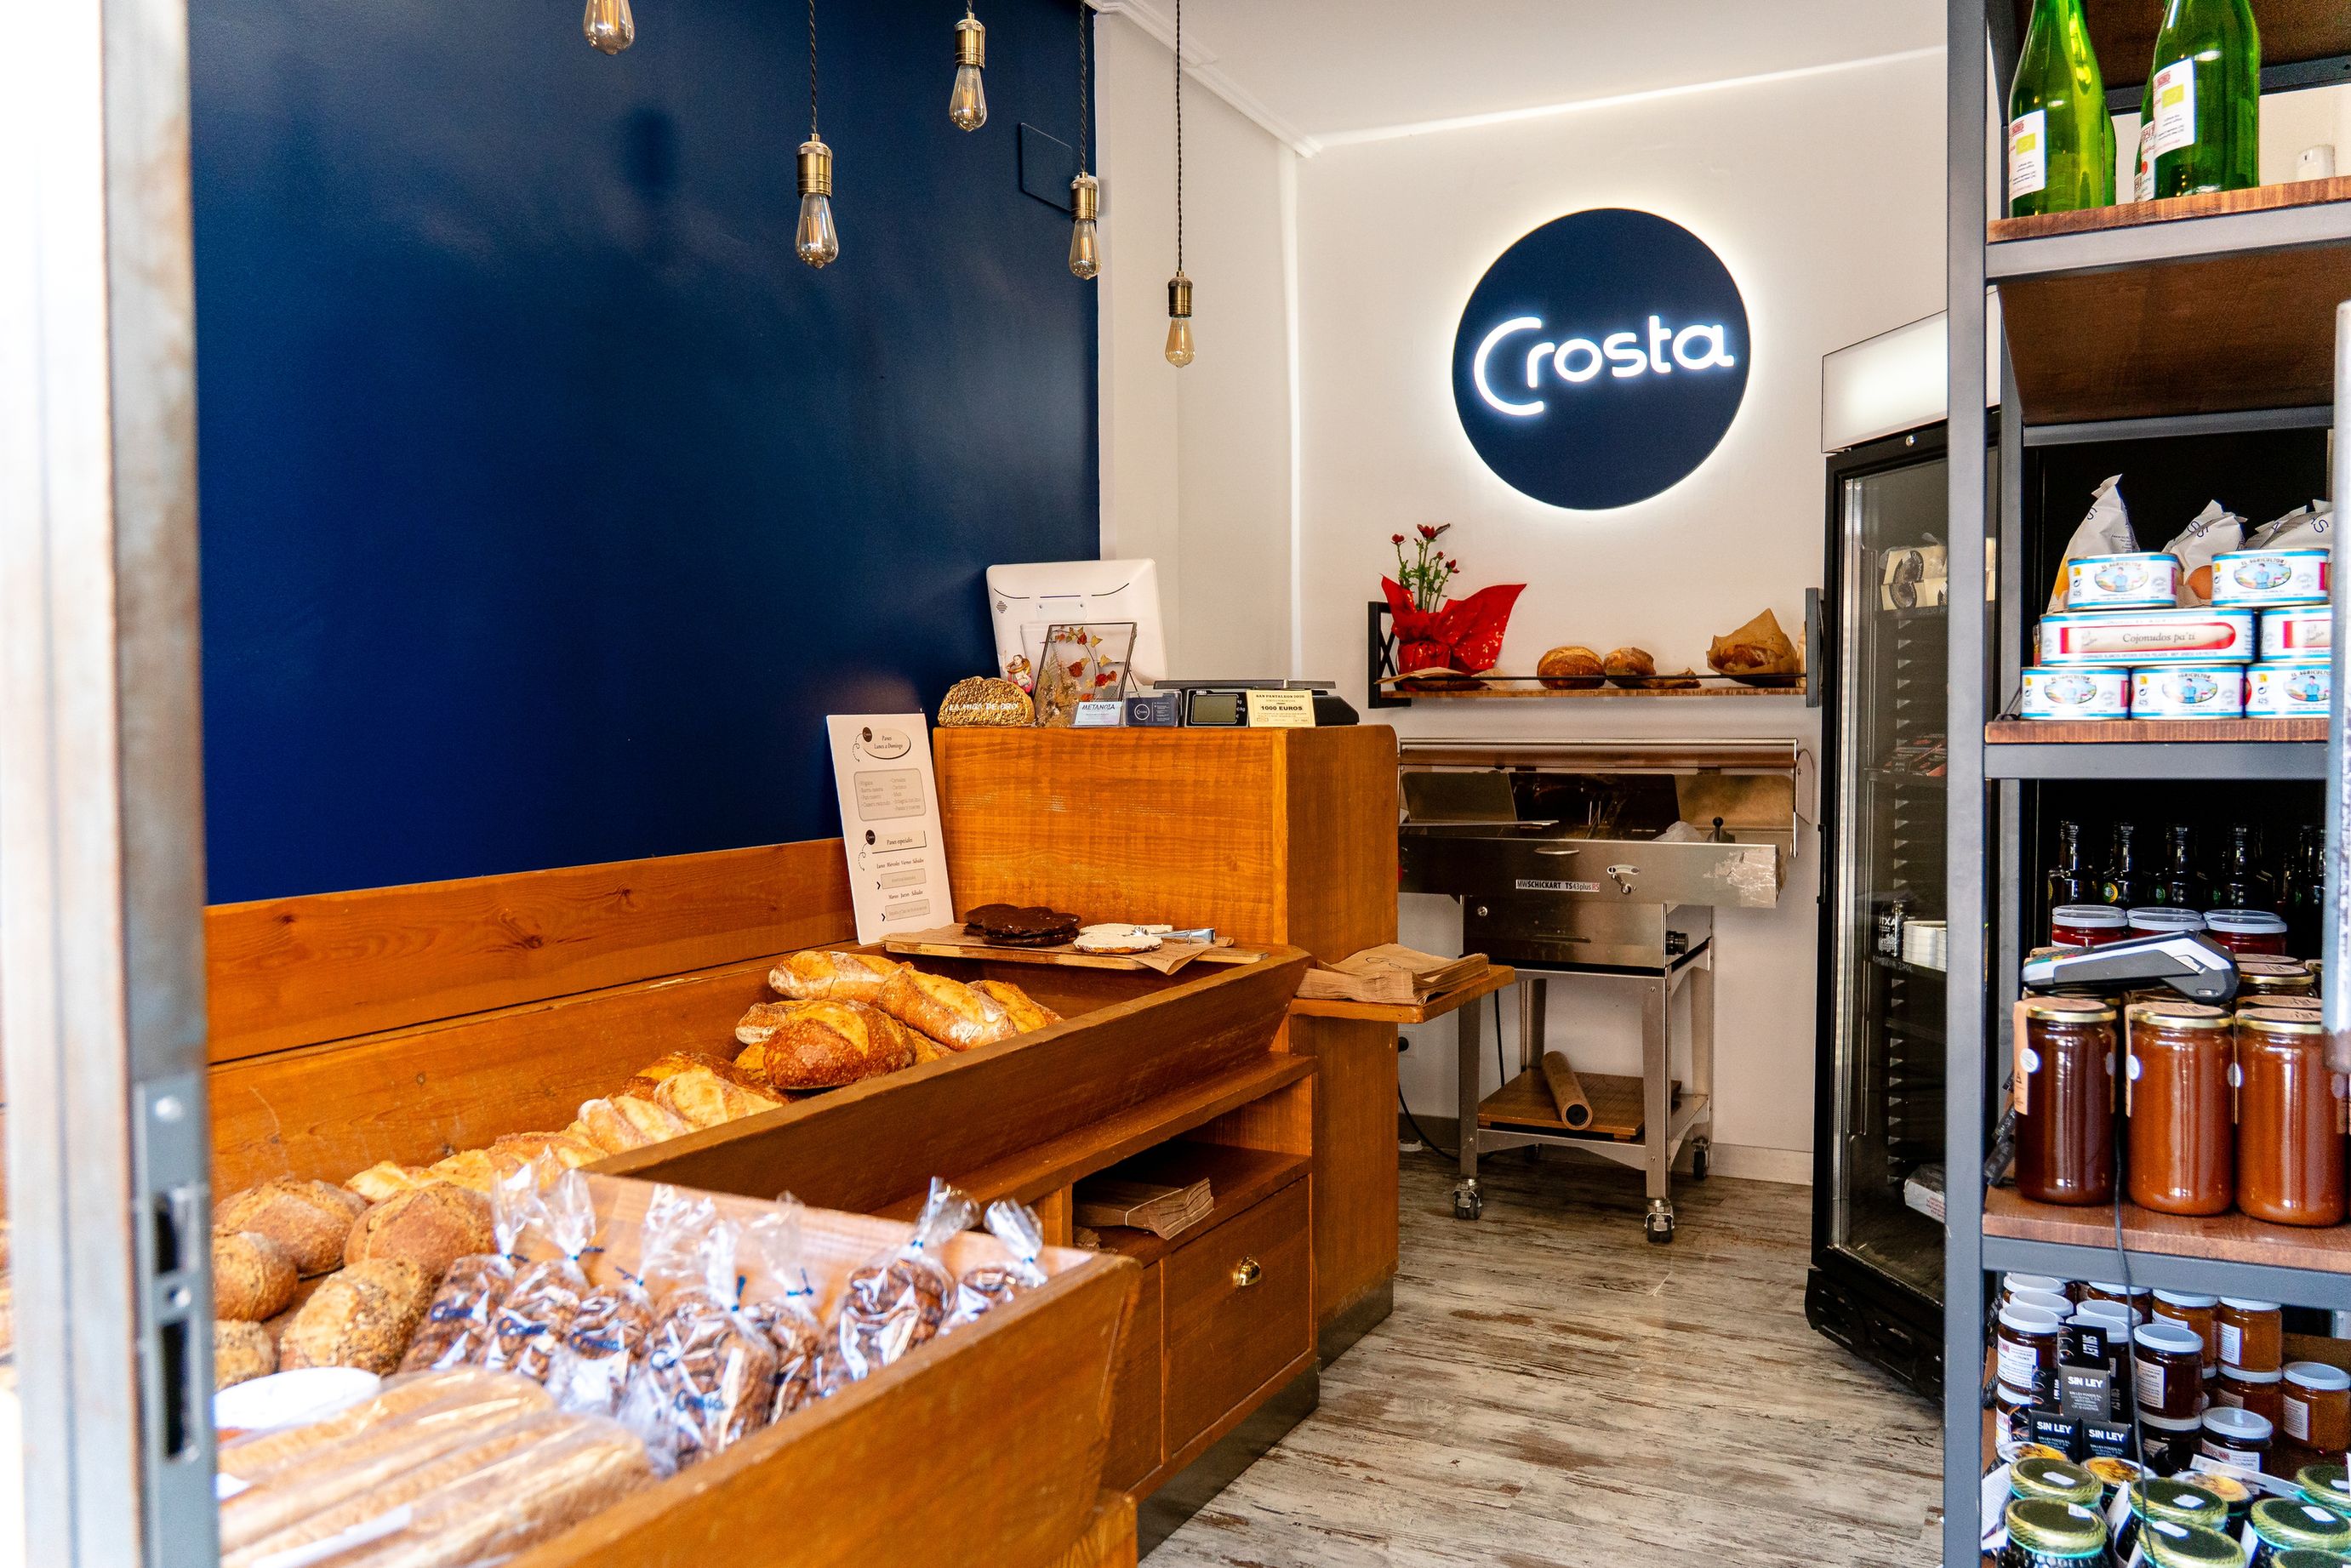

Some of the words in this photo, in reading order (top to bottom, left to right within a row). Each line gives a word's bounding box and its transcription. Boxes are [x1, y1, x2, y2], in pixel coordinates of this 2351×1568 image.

[1473, 315, 1735, 416] Crosta
[2122, 632, 2171, 644] Cojonudos
[949, 703, 961, 711] LA
[962, 703, 983, 711] MIGA
[985, 702, 997, 710] DE
[1000, 702, 1019, 710] ORO
[2068, 1376, 2083, 1386] SIN
[2085, 1377, 2103, 1388] LEY
[2036, 1421, 2052, 1432] SIN
[2053, 1423, 2072, 1434] LEY
[2088, 1428, 2104, 1440] SIN
[2106, 1430, 2125, 1442] LEY
